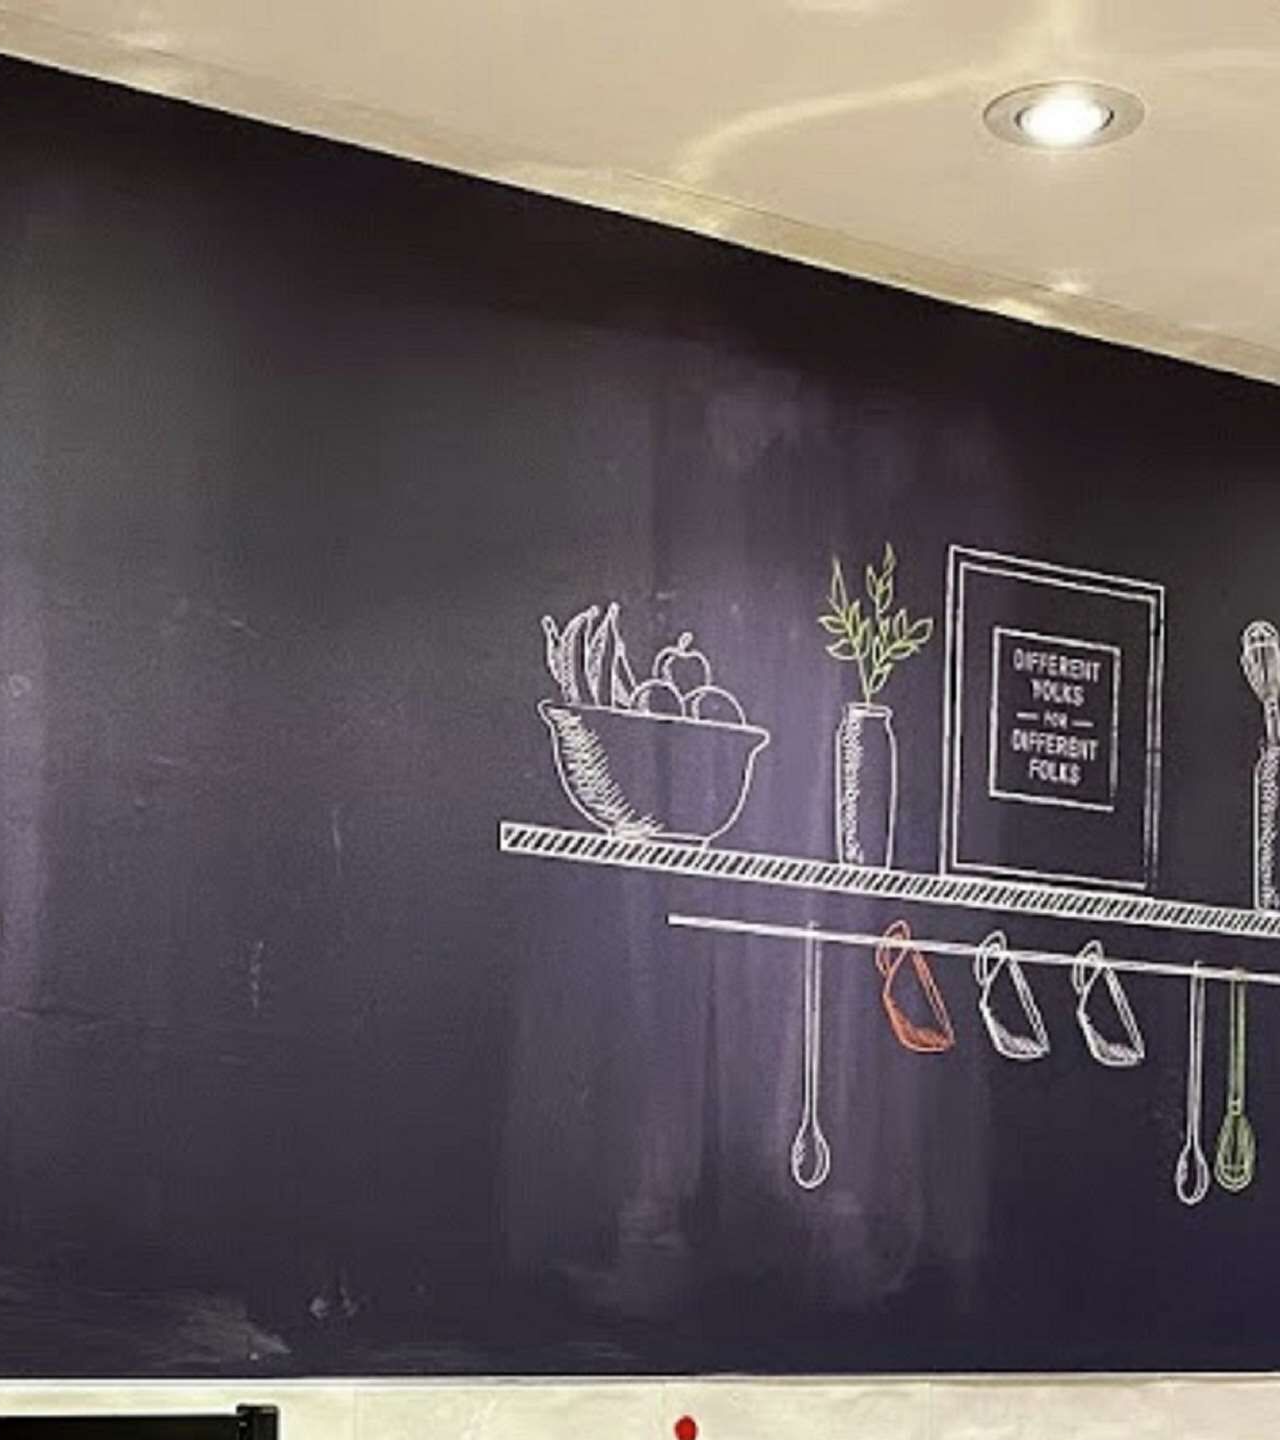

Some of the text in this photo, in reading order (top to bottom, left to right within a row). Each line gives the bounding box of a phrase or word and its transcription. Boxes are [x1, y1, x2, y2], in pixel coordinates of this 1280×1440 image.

[1012, 648, 1101, 683] DIFFERENT
[1031, 678, 1085, 706] YOLKS
[1011, 728, 1099, 761] DIFFERENT
[1028, 758, 1081, 786] FOLKS
